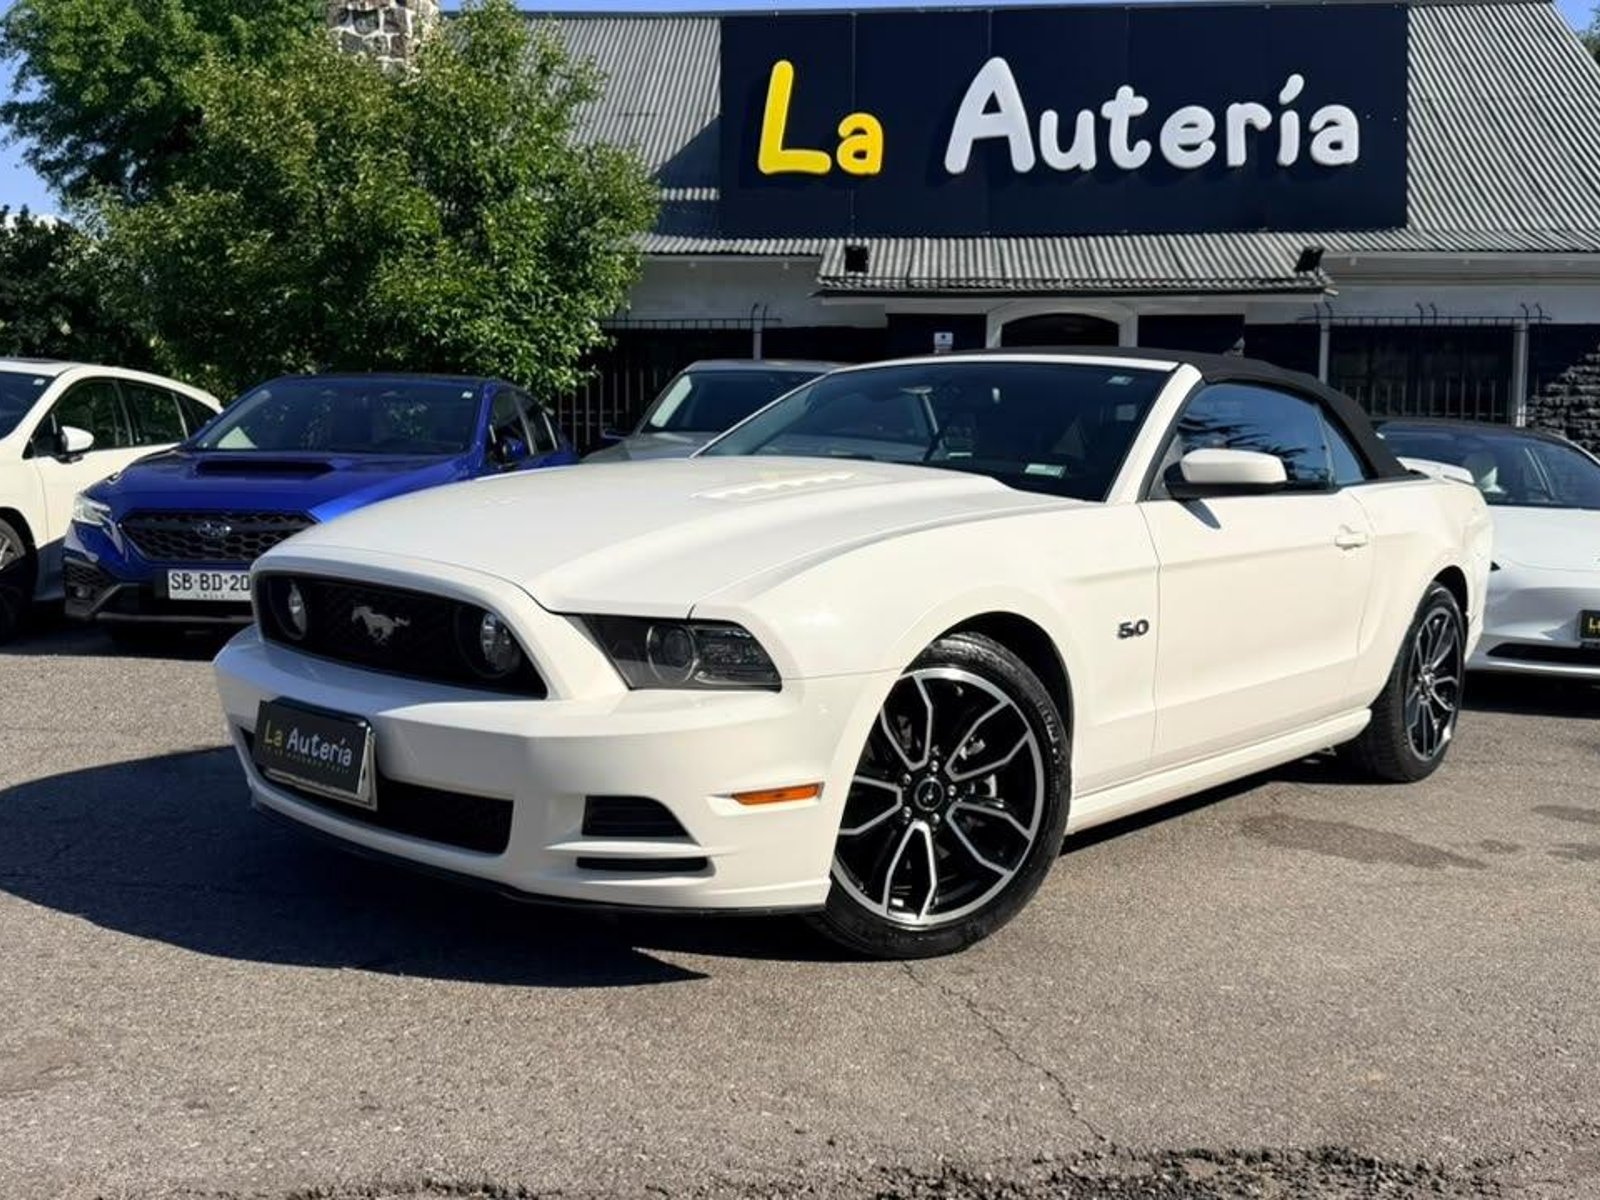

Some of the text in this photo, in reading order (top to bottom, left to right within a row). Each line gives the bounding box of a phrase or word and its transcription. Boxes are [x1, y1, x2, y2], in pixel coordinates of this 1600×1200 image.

[758, 57, 1360, 175] La Autería
[264, 720, 283, 747] La
[286, 727, 353, 767] Autería
